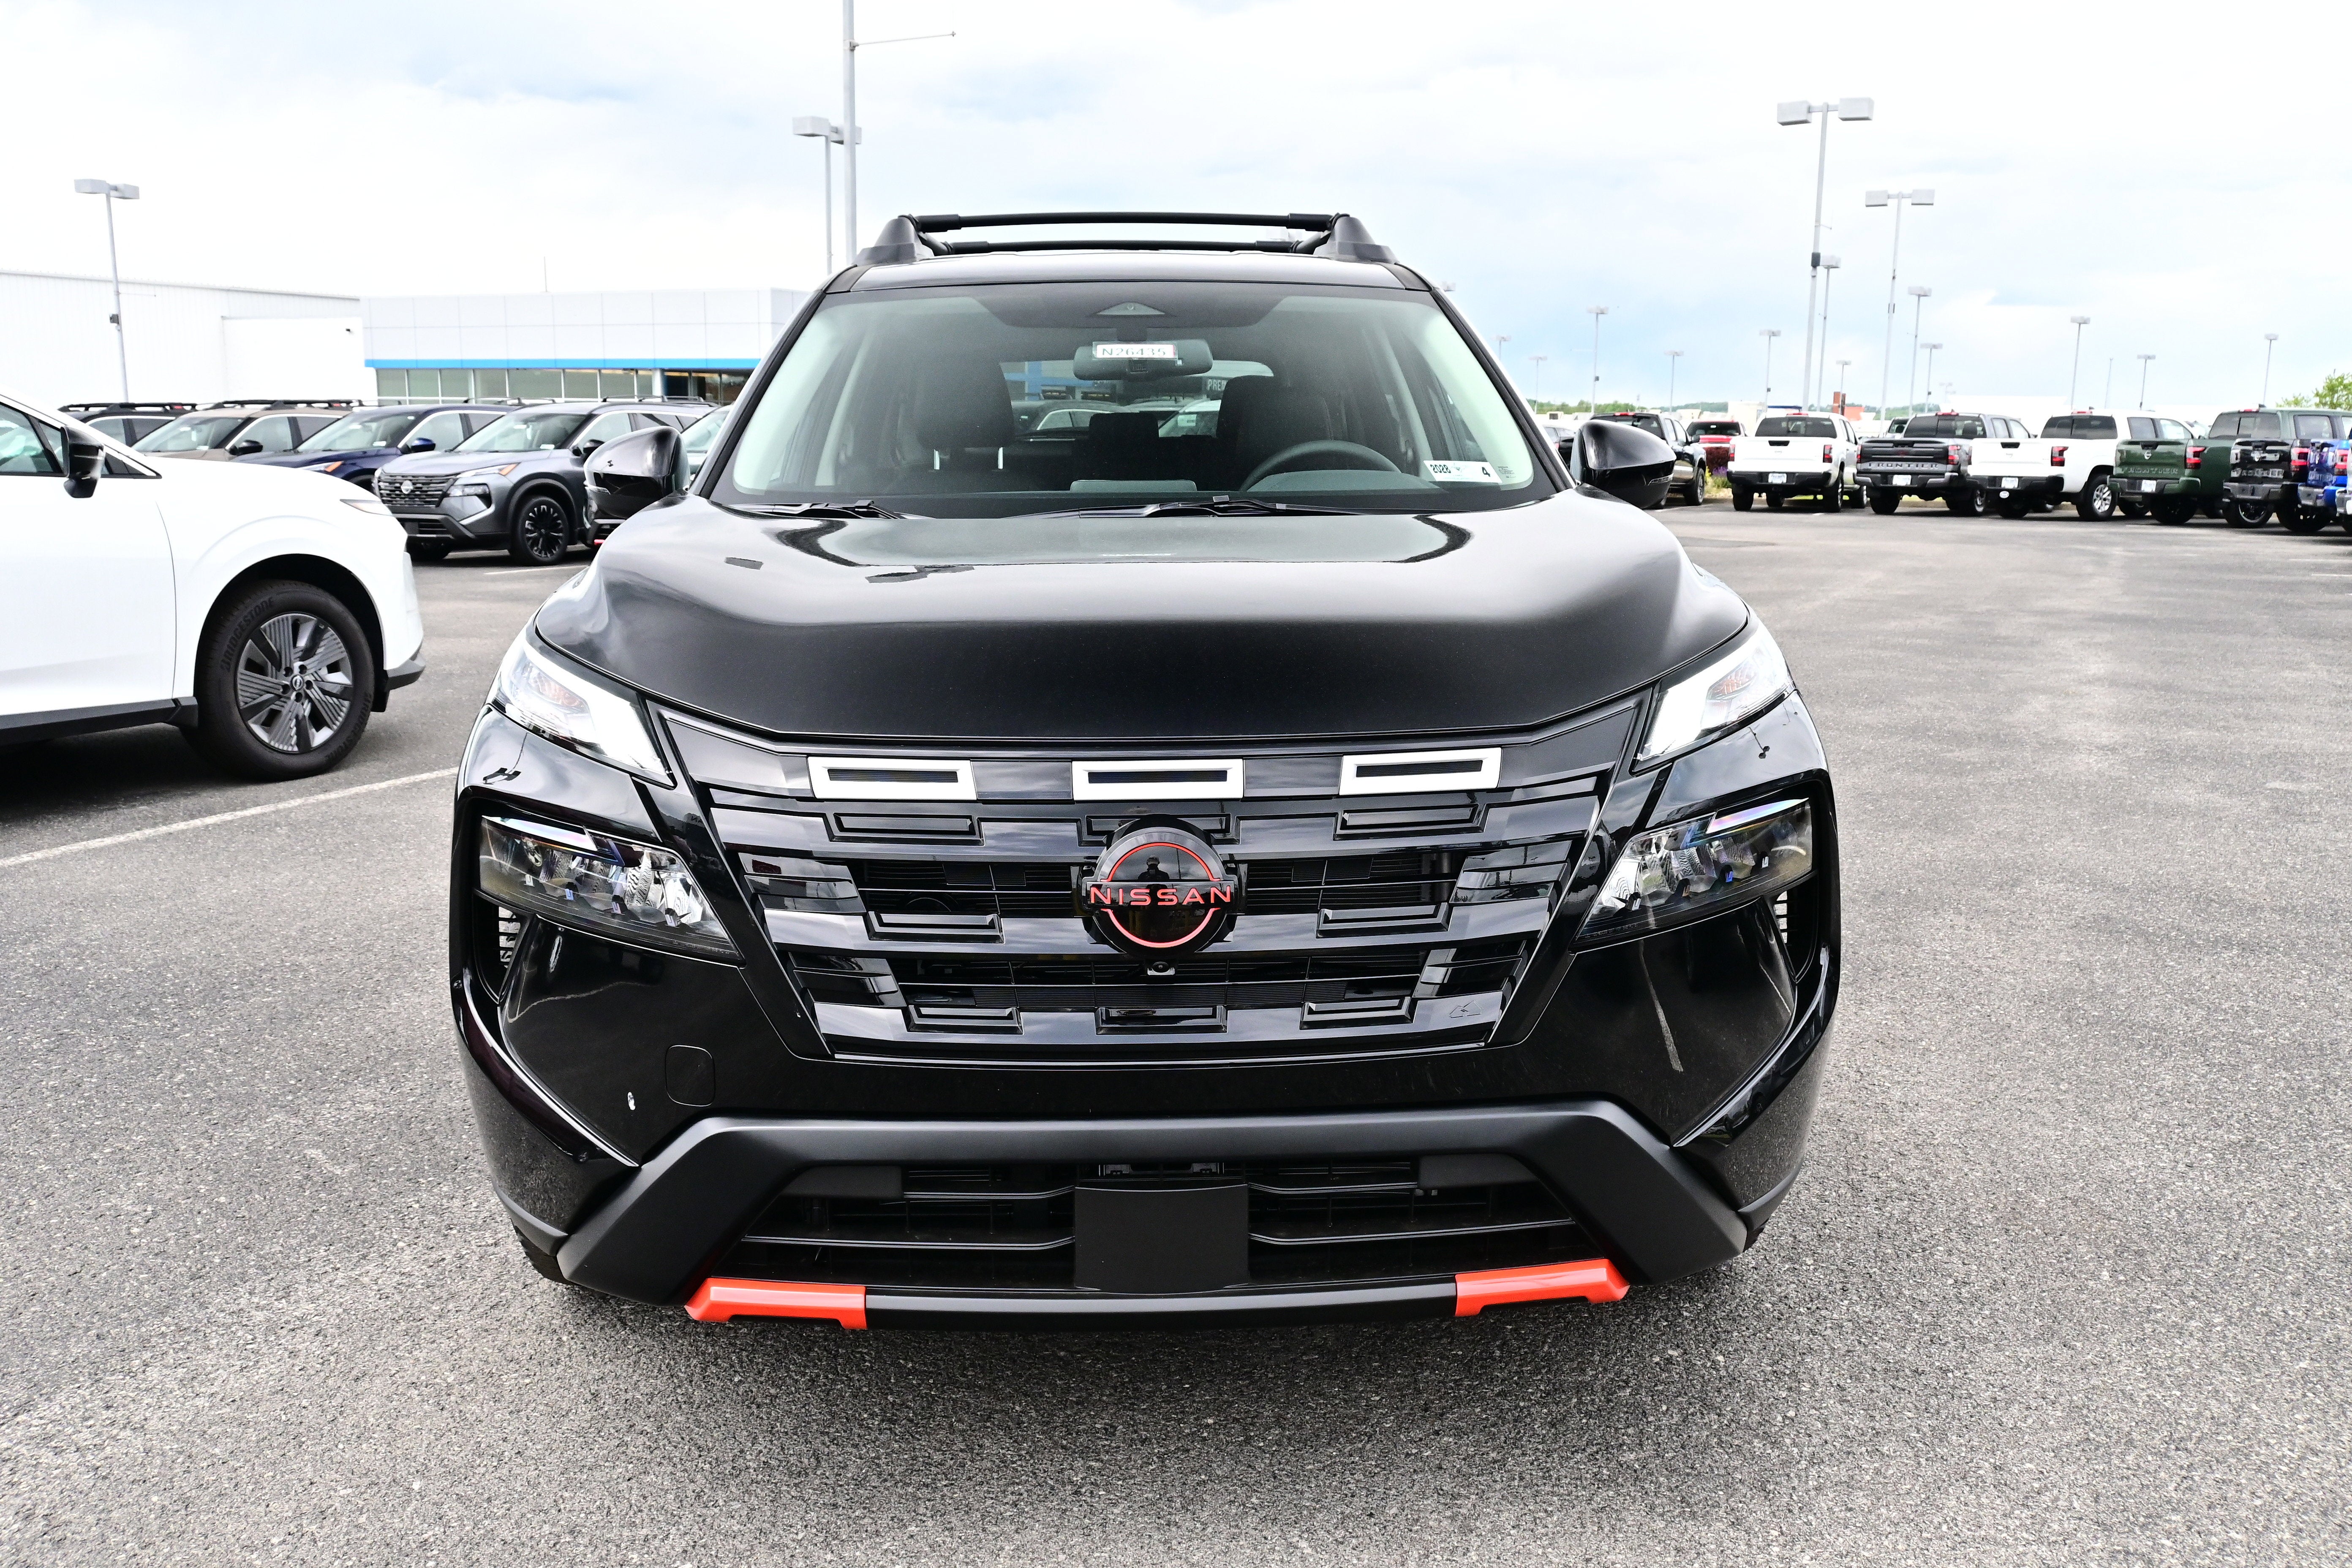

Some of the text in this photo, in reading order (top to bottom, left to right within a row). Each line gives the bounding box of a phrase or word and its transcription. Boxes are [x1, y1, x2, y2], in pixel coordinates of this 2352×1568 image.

[1102, 348, 1166, 356] N26435
[1430, 464, 1451, 474] 2028
[1481, 466, 1491, 477] 4
[1089, 885, 1231, 906] NISSAN
